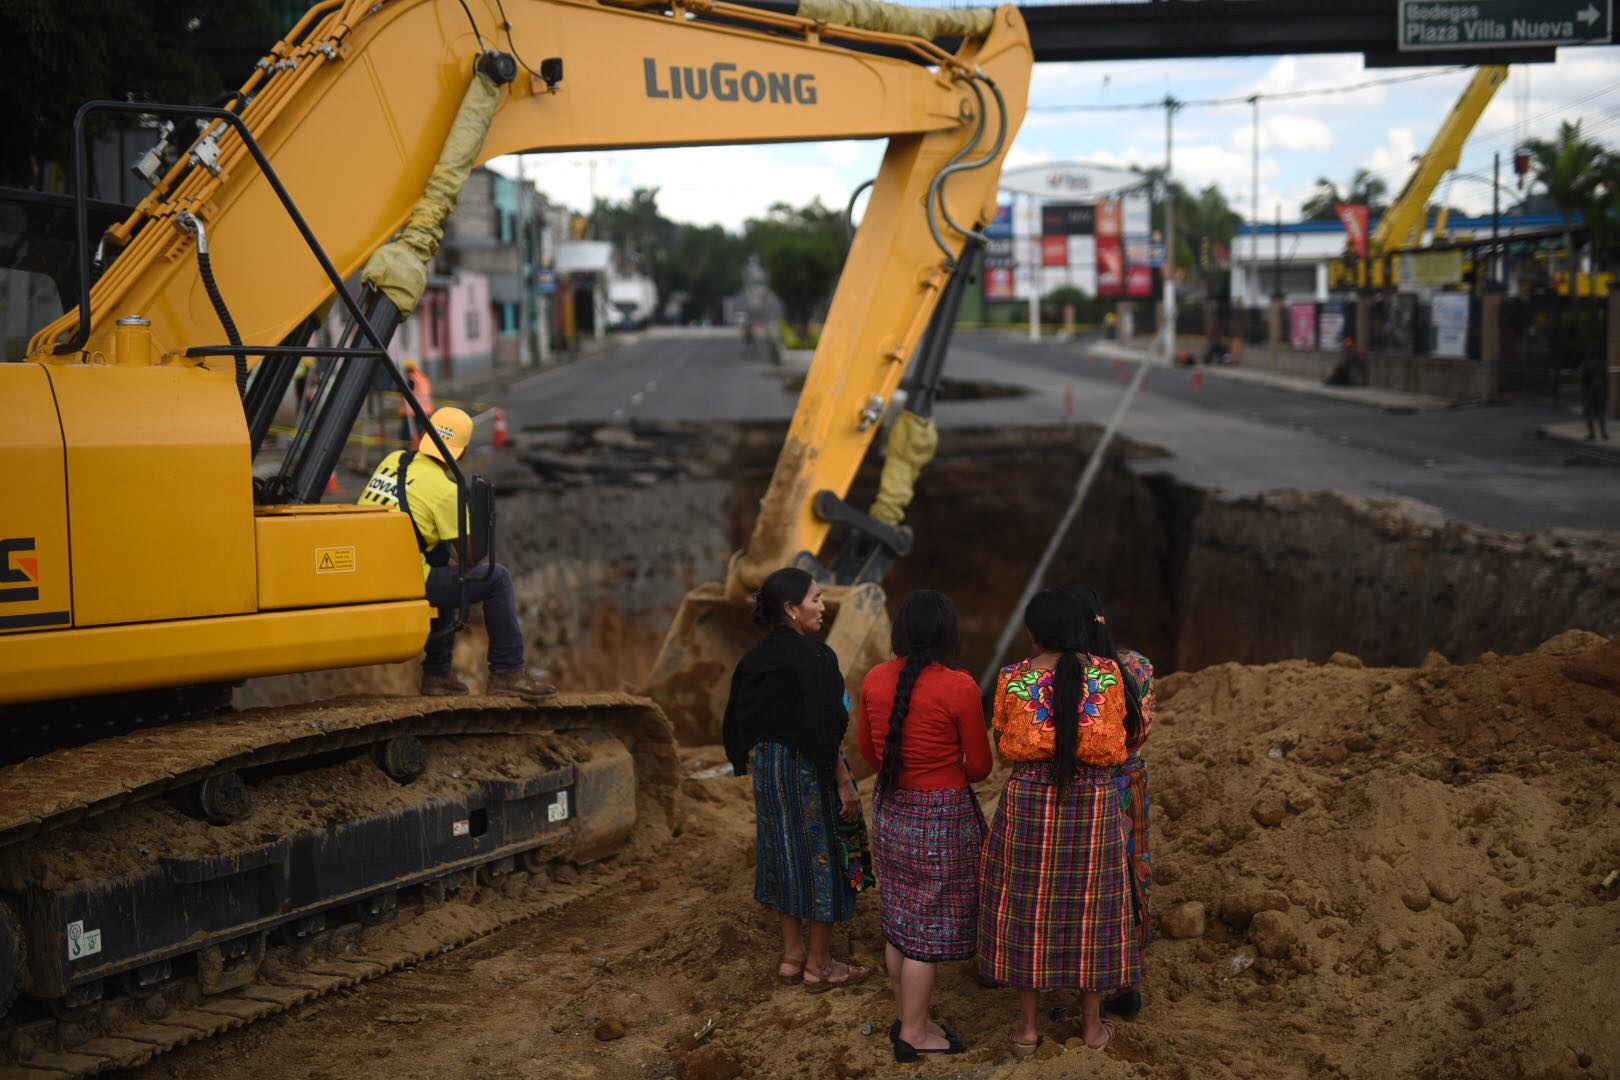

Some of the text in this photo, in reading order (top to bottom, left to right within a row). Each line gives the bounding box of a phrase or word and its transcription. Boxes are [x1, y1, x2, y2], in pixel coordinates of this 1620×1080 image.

[1406, 5, 1480, 23] Bodegas
[1406, 18, 1574, 42] Plaza Villa Nueva
[369, 477, 400, 497] COVIA
